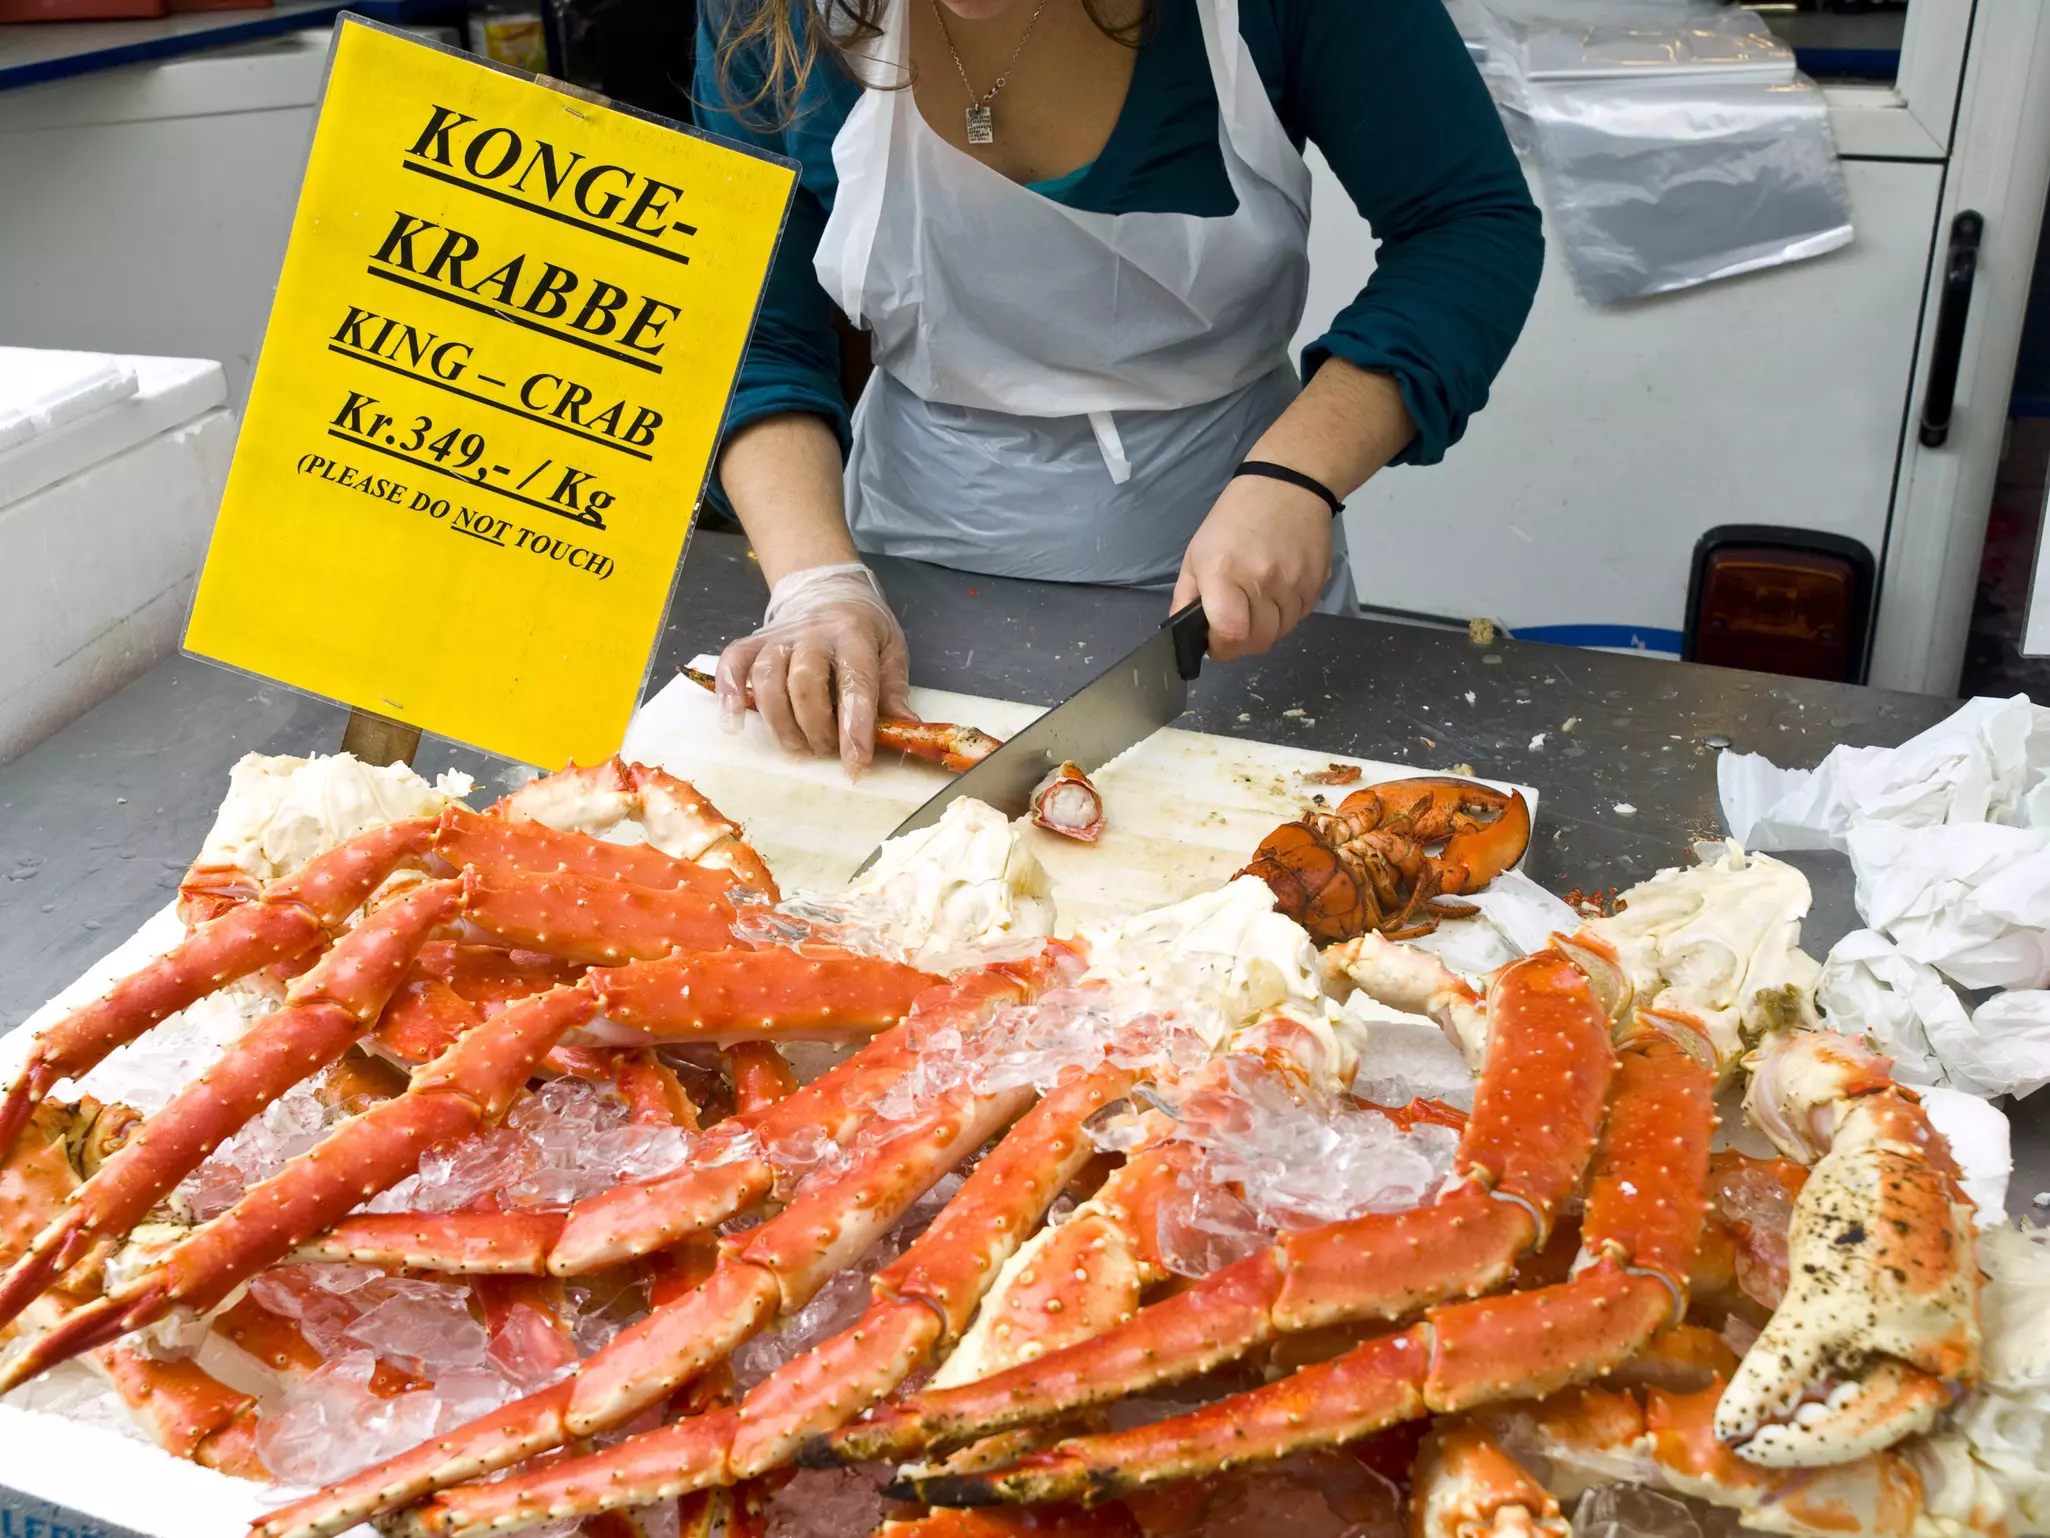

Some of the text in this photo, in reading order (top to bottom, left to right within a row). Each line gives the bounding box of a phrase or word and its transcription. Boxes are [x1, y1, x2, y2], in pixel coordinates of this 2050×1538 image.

[404, 104, 698, 239] KONGE-
[369, 210, 682, 357] KRABBE
[329, 305, 474, 382] KING
[520, 373, 664, 448] CRAB
[297, 453, 615, 581] (PLEASE DO NOT TOUCH)
[546, 466, 617, 529] Kg
